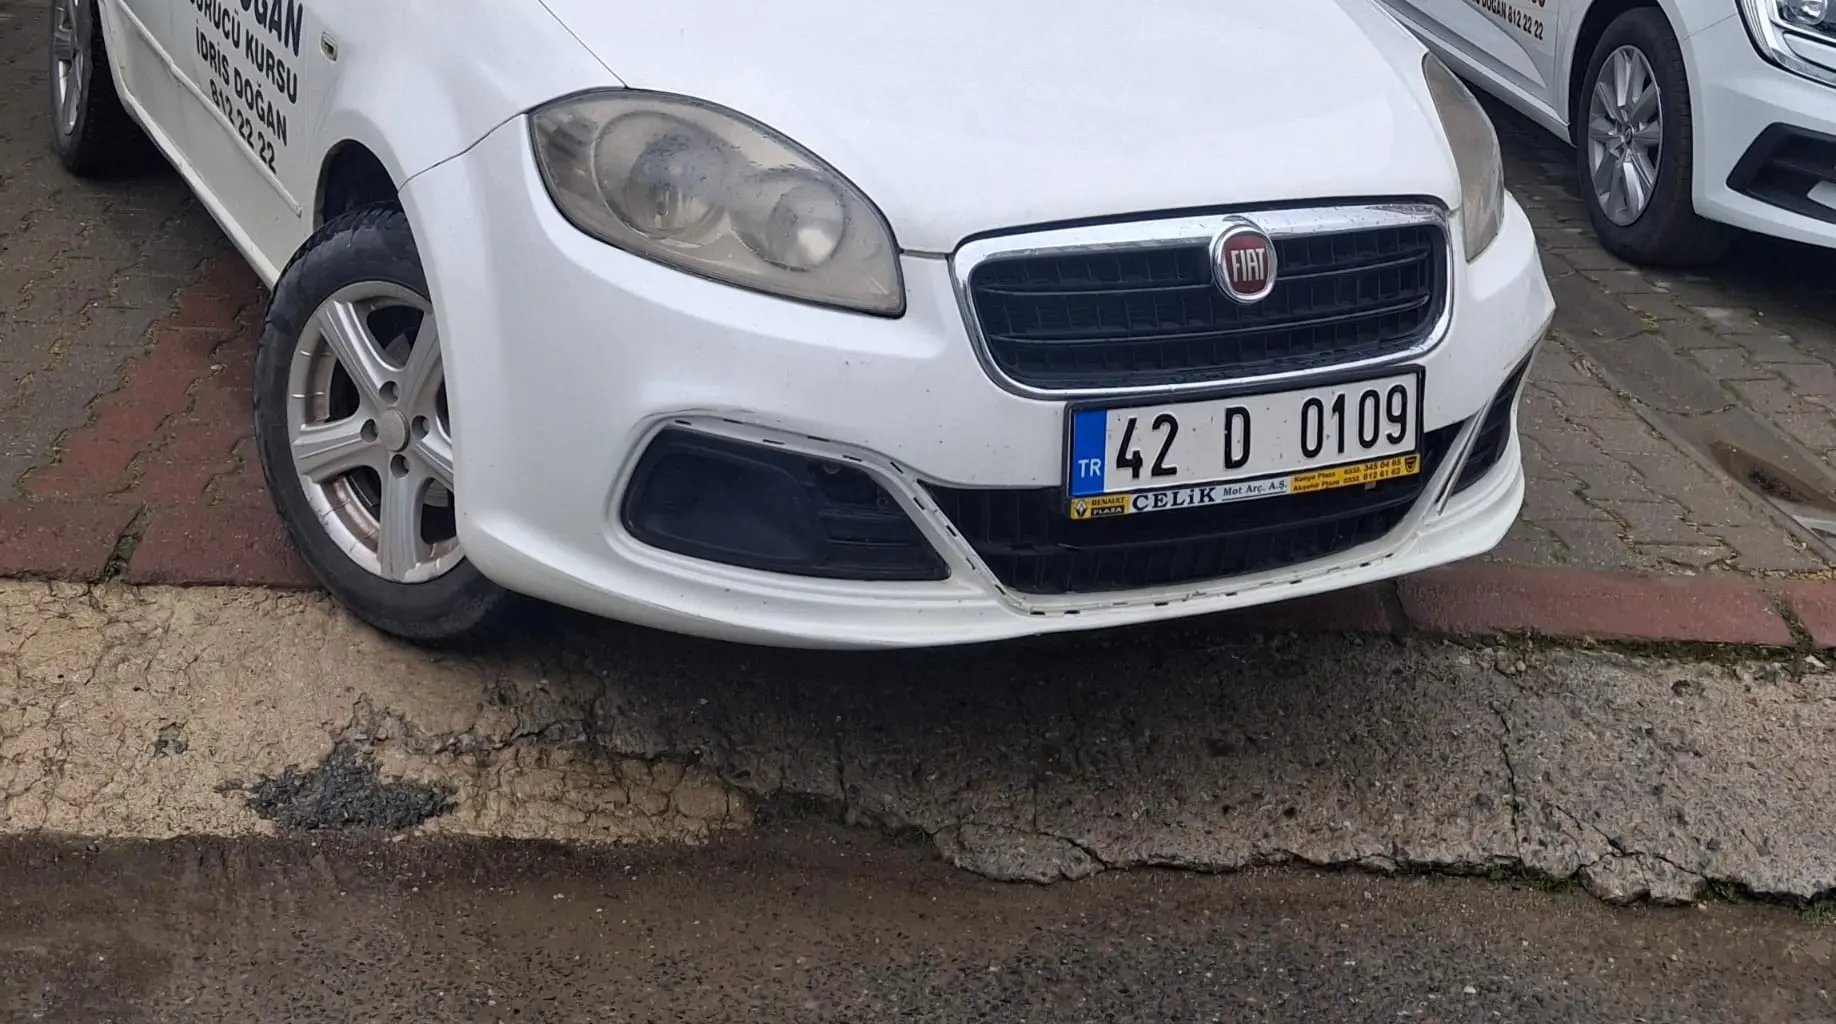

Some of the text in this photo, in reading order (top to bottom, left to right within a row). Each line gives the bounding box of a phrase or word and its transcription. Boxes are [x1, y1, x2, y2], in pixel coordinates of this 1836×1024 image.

[1508, 5, 1522, 29] 812
[1523, 13, 1533, 35] 22
[1534, 19, 1545, 41] 22
[195, 19, 288, 147] İDRİS DOĞAN
[245, 27, 298, 105] KURSU
[209, 78, 278, 175] 812 22 22
[1230, 248, 1265, 282] FIAT
[1078, 384, 1408, 481] TR 42 D 0109
[1091, 496, 1125, 507] RENAULT
[1223, 486, 1245, 497] Mot
[1093, 506, 1123, 516] PLAZA
